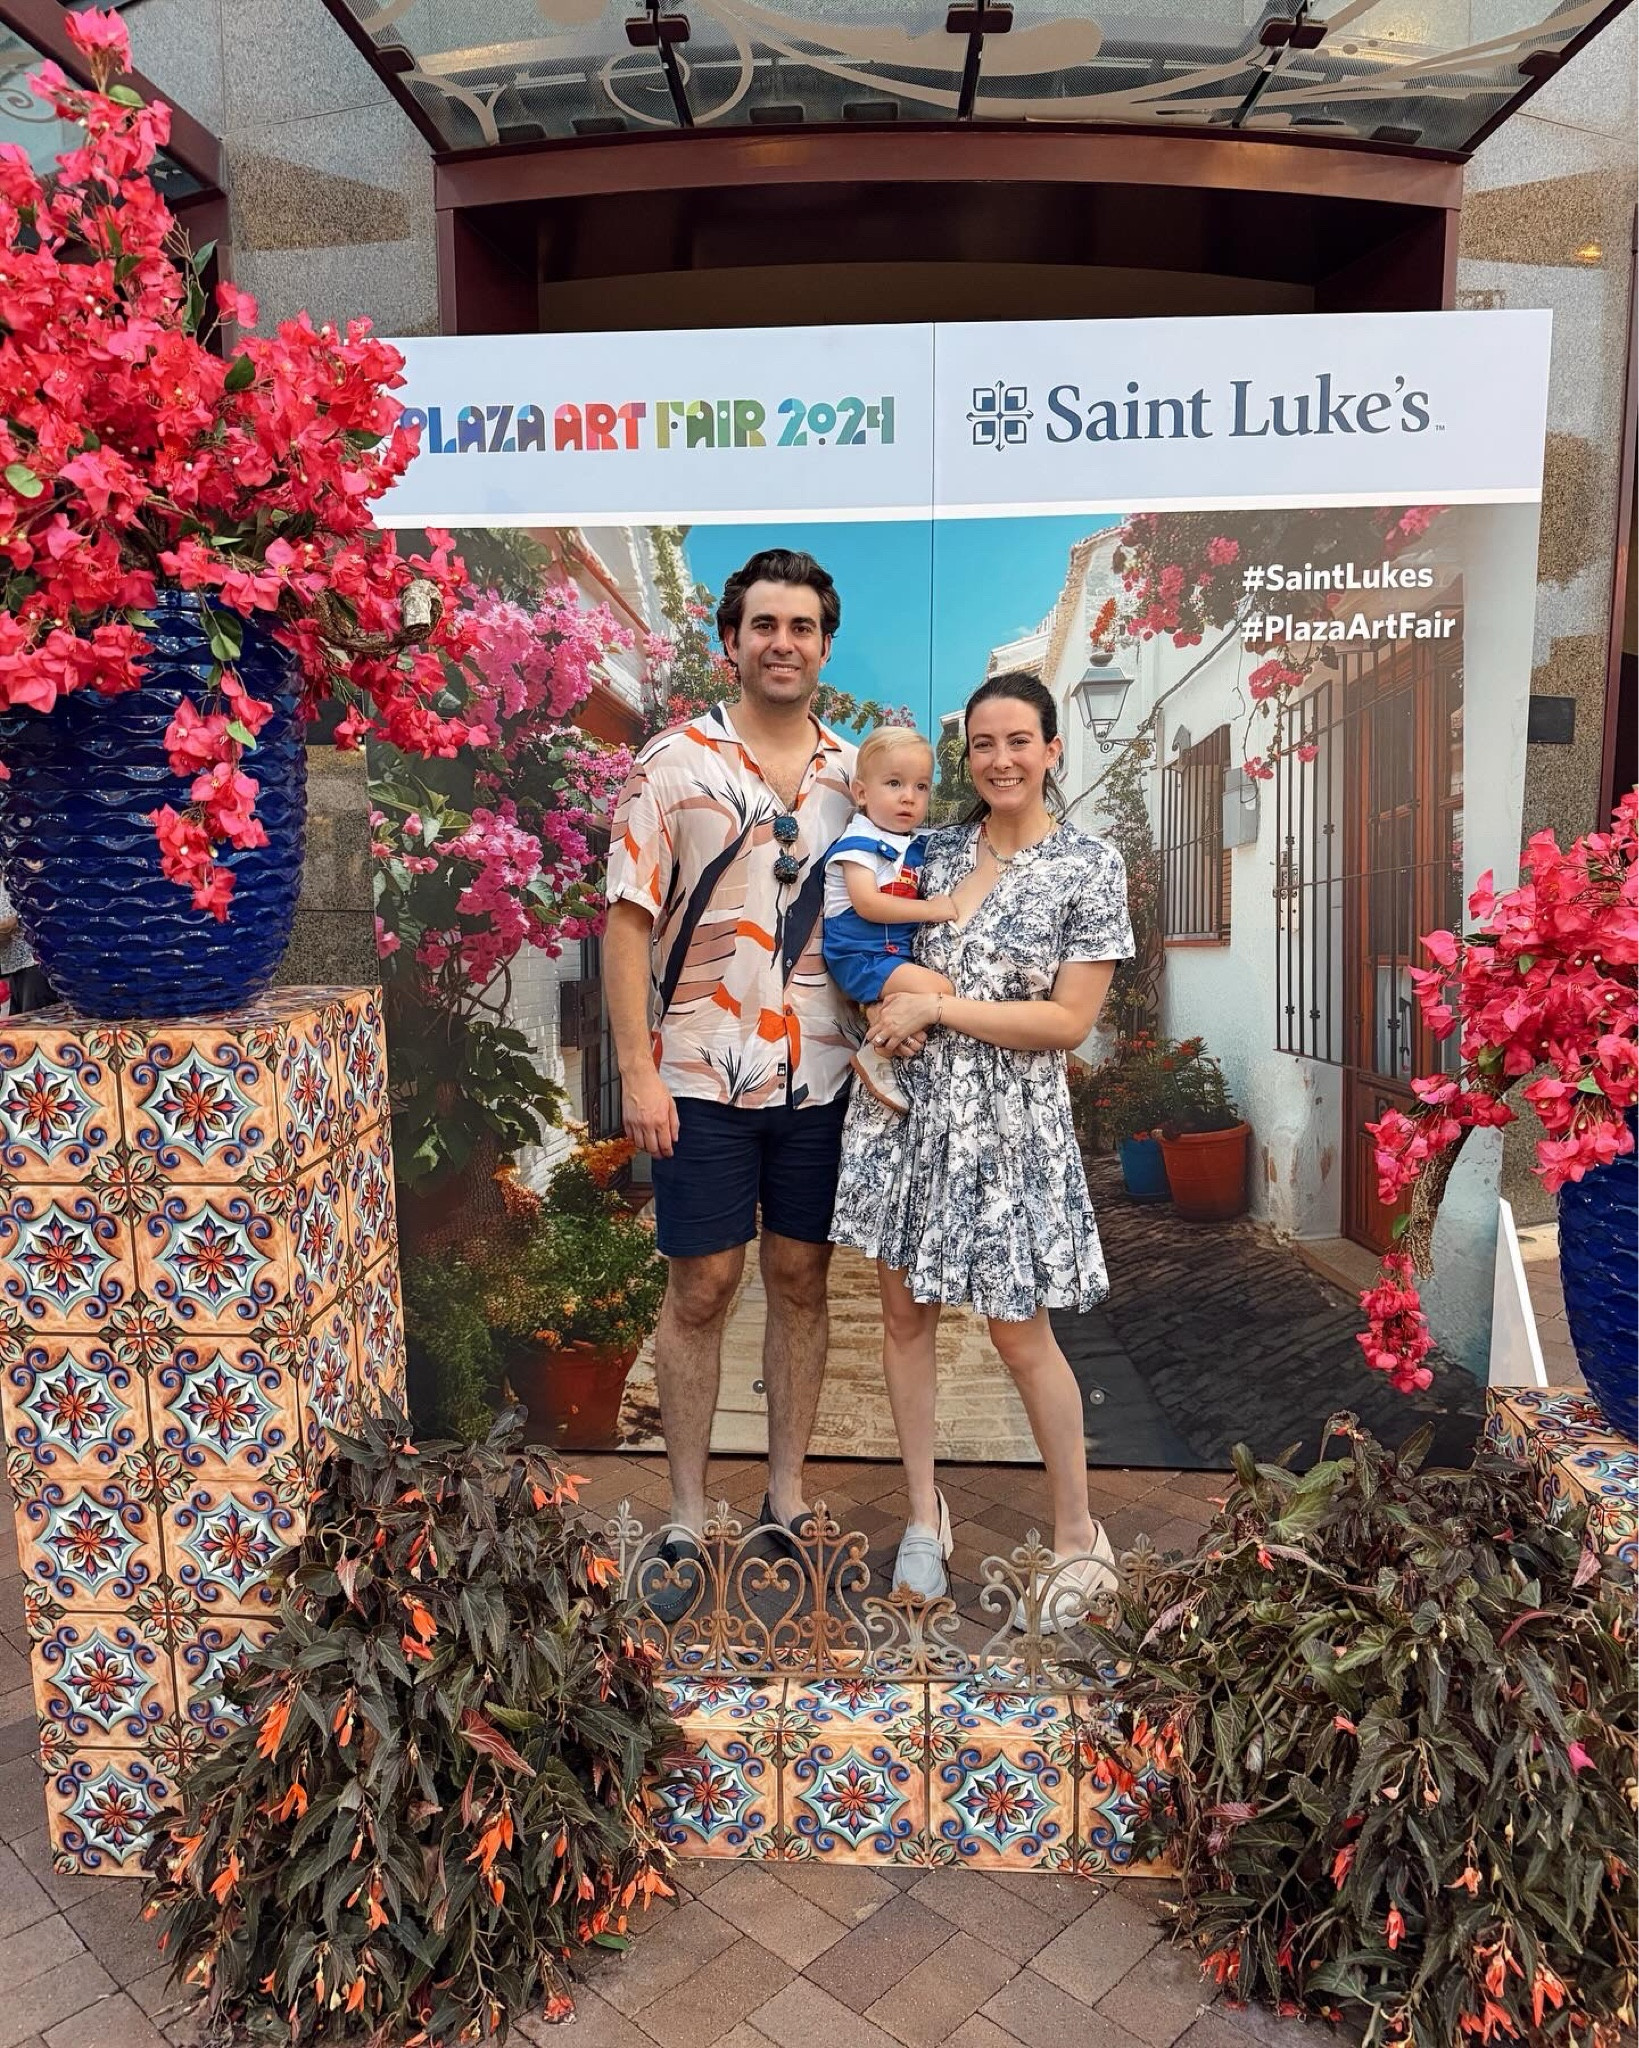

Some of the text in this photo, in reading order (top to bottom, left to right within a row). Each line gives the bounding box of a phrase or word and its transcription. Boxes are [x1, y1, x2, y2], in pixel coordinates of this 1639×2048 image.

[555, 402, 646, 451] ART
[656, 399, 767, 449] FAIR
[777, 396, 895, 447] 2024
[1046, 381, 1212, 443] Saint
[1229, 372, 1430, 437] Luke's
[1242, 561, 1433, 591] #SaintLukes
[1240, 611, 1456, 643] #PlazaArtFair
